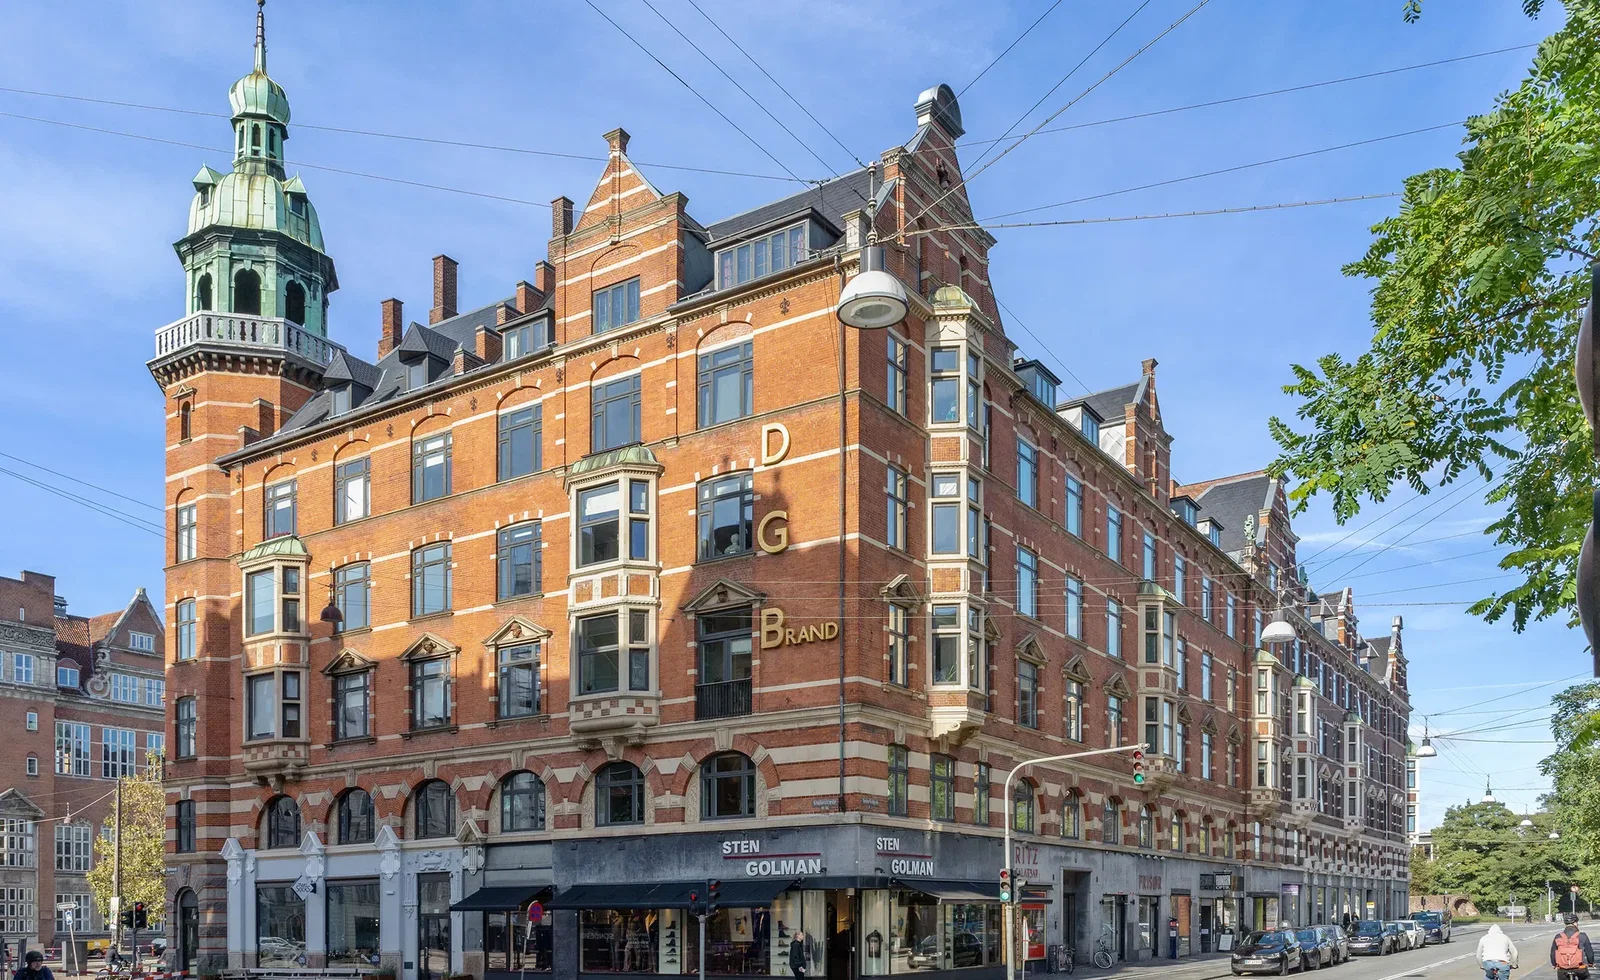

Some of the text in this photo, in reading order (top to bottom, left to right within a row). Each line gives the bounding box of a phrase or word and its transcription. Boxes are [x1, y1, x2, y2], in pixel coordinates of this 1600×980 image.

[761, 422, 791, 466] D
[757, 510, 789, 554] G
[722, 839, 760, 854] STEN
[876, 836, 900, 851] STEN
[1015, 846, 1039, 865] RITZ
[745, 858, 821, 876] GOLMAN
[891, 858, 934, 876] GOLMAN
